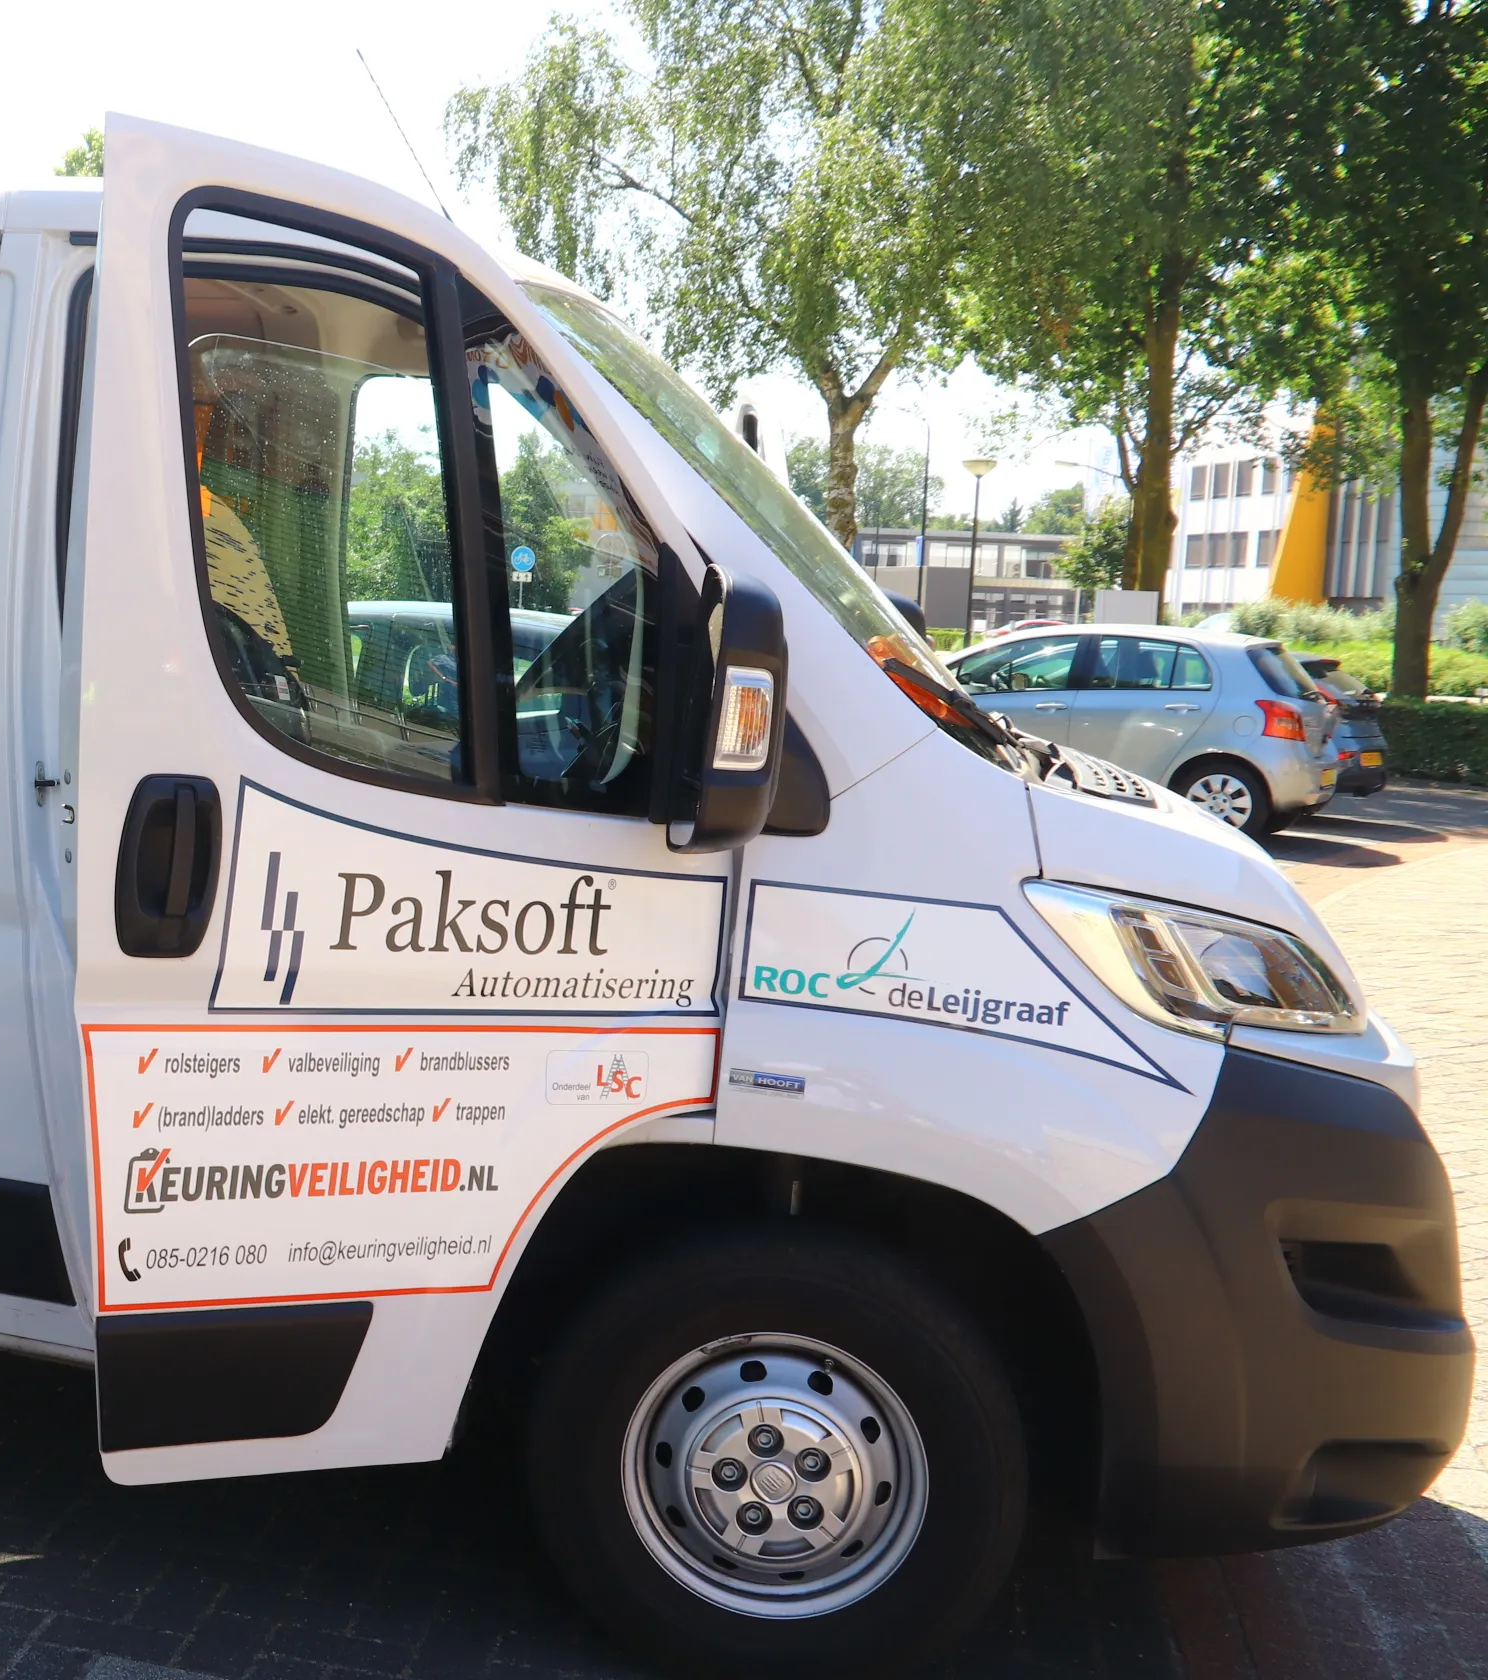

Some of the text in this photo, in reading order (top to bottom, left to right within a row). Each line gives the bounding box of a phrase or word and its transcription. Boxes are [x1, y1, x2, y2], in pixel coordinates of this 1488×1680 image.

[451, 966, 695, 1008] Automatisering
[753, 965, 831, 998] ROC
[888, 982, 1071, 1027] deLeijgraaf
[164, 1051, 510, 1079] rolsteigers valbeveiliging brandblussers
[596, 1064, 642, 1099] LSC
[732, 1073, 802, 1090] VAN HOOFT
[552, 1081, 591, 1092] Onderdeel
[577, 1093, 590, 1101] van
[157, 1101, 506, 1133] (brand)ladders elekt. gereedschap trappen
[135, 1149, 500, 1204] KEURINGVEILIGHEID.NL
[145, 1234, 493, 1271] 085-0216 080 info@keuringveiligheid.nl
